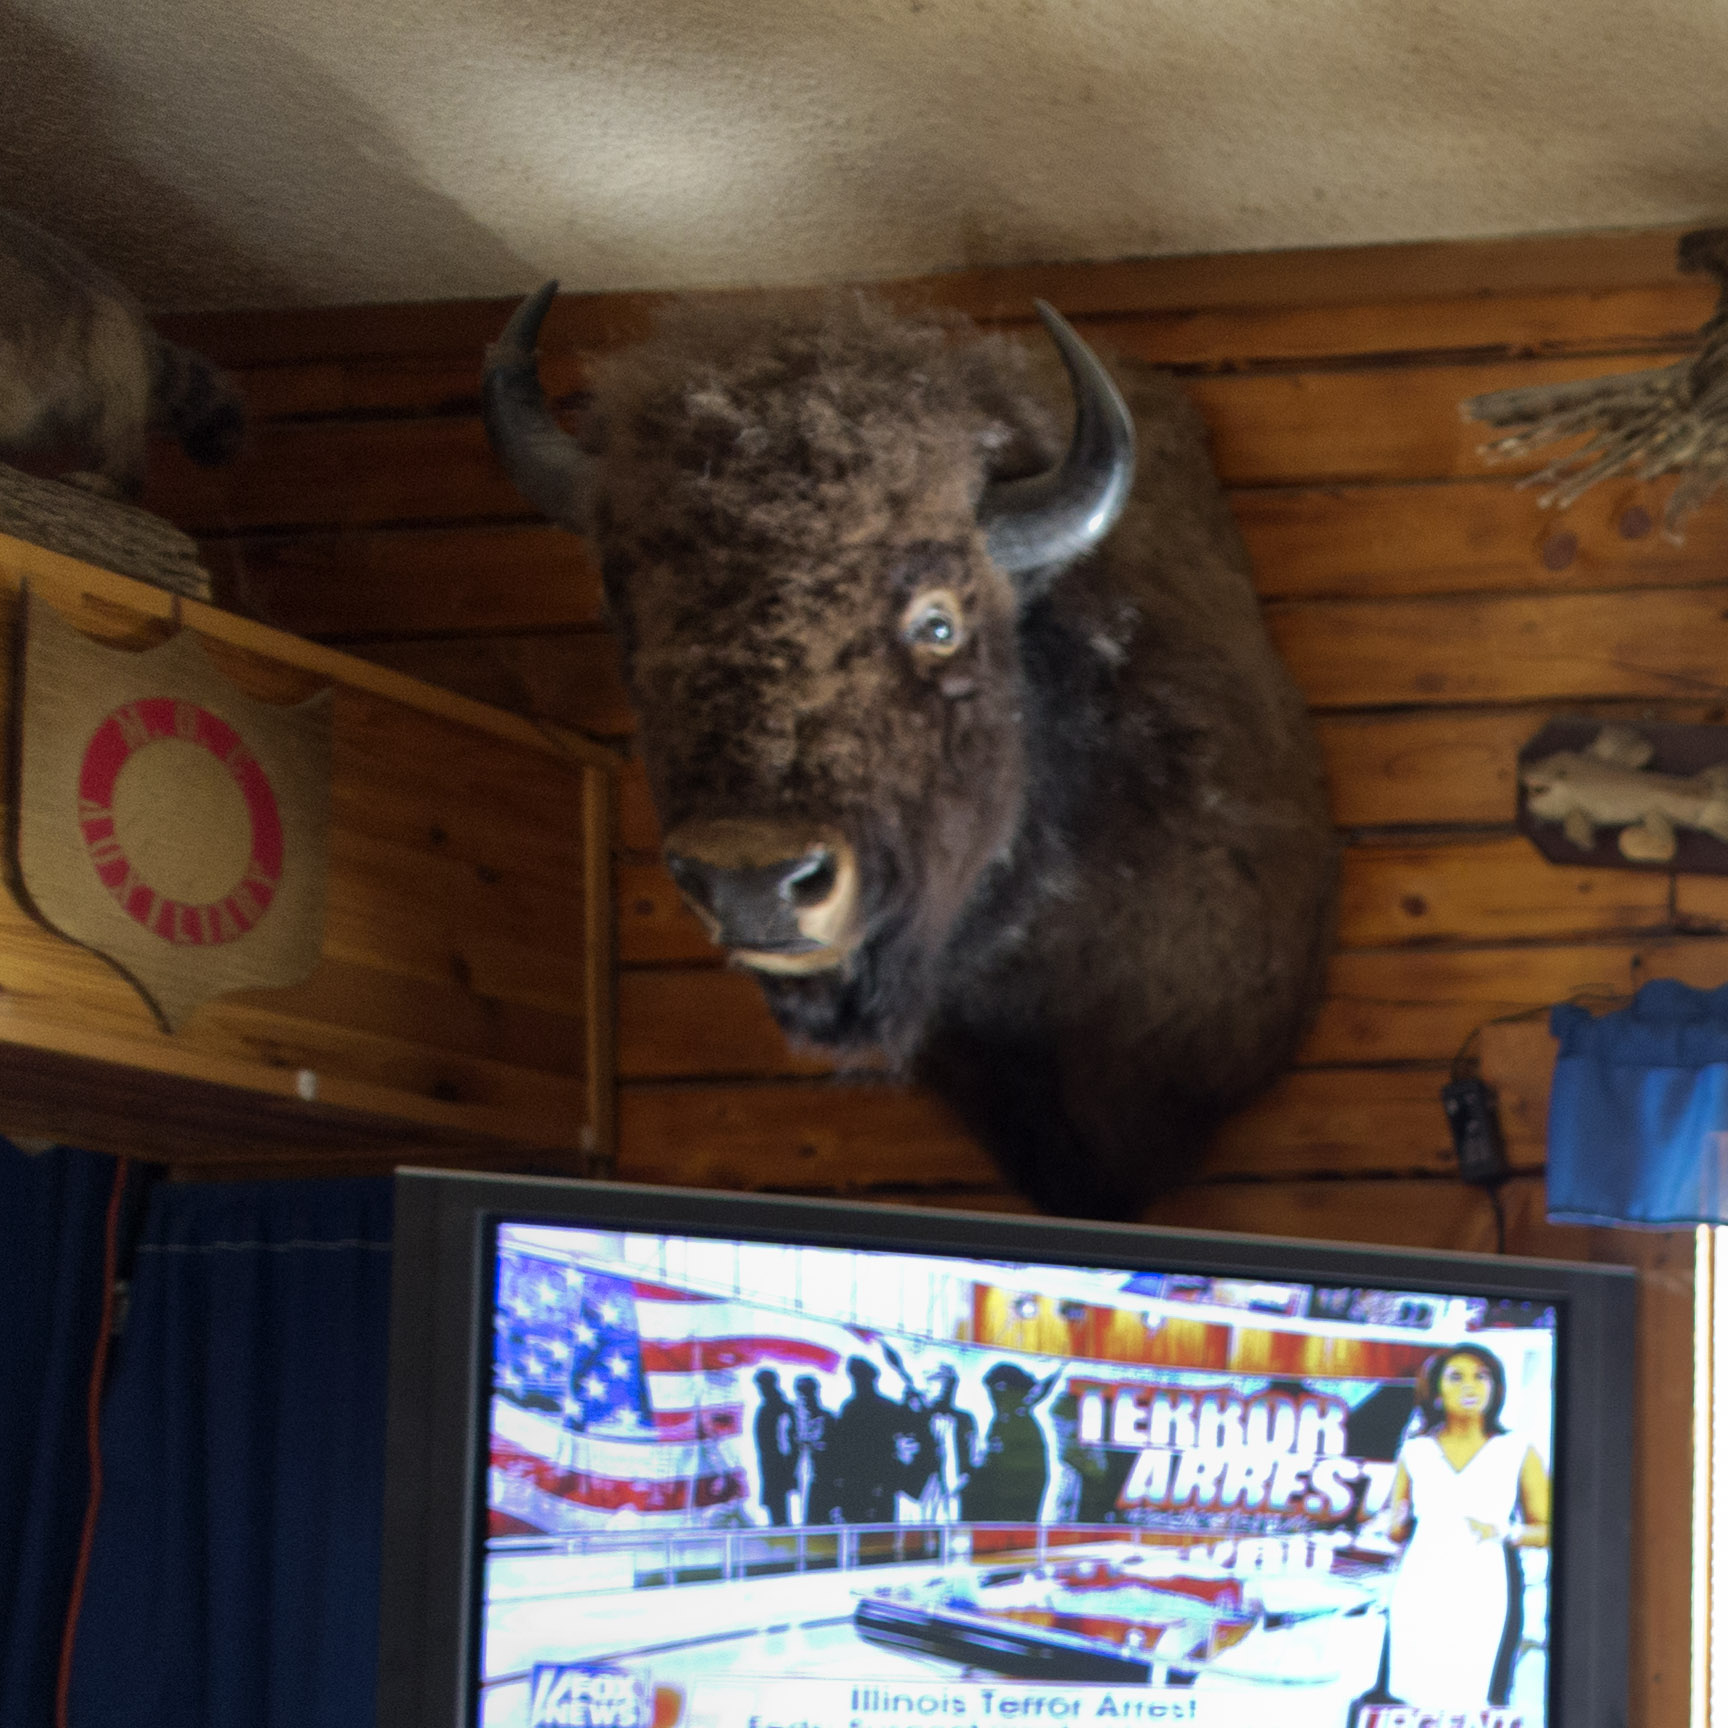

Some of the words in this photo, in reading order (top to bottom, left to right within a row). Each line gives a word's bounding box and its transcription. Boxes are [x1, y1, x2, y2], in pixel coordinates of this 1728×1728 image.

[1120, 1447, 1398, 1518] ARREST
[542, 1700, 638, 1728] NEWS
[851, 1687, 966, 1713] Illinois
[981, 1689, 1081, 1718] Terror
[1096, 1693, 1197, 1719] Arrest
